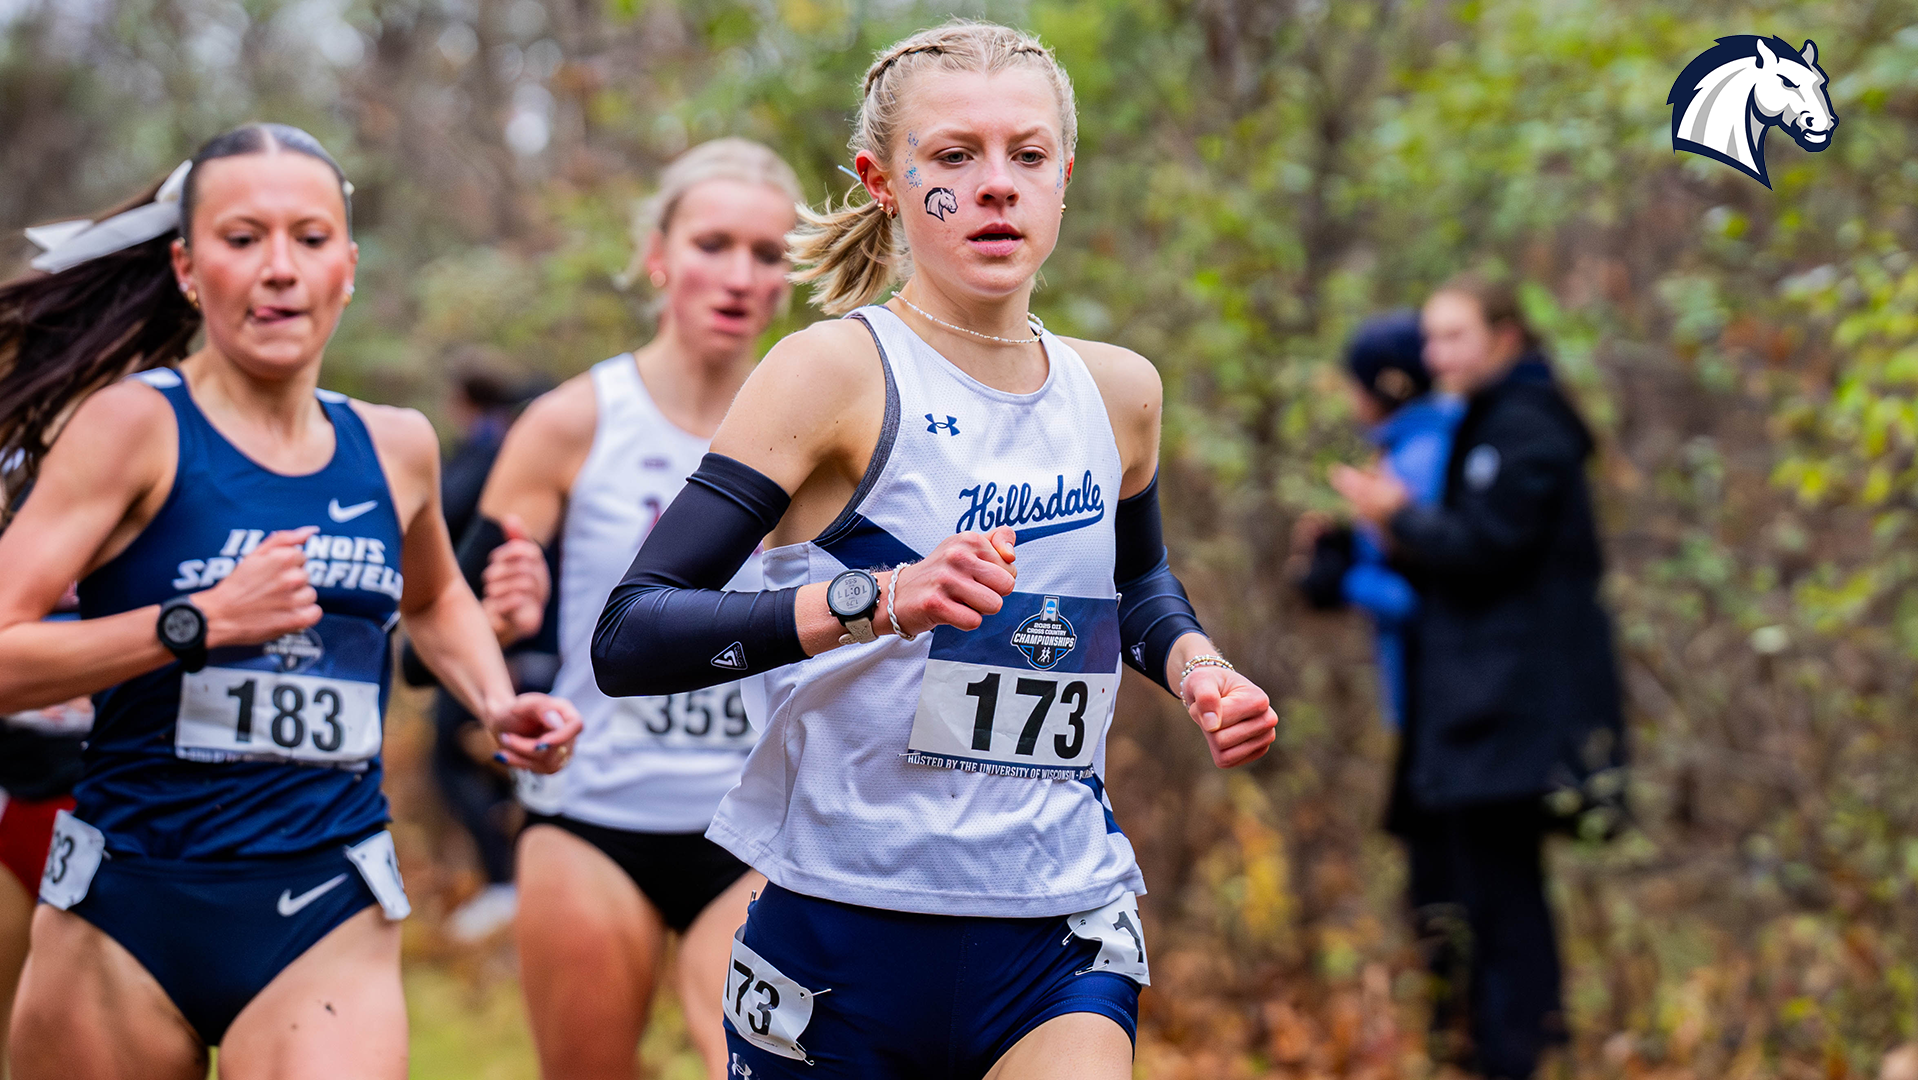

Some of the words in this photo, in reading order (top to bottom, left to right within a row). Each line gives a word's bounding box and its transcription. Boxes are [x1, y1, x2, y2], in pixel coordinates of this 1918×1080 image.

[956, 470, 1105, 534] Hillsdale
[219, 529, 386, 564] ILNOIS
[172, 556, 404, 600] SPGFIEL
[837, 585, 868, 599] 10:11
[1014, 633, 1074, 647] CHAMPIONSHIPS
[227, 679, 342, 752] 183
[645, 689, 749, 736] 359
[966, 672, 1089, 759] 173
[907, 754, 944, 768] HOSTED
[945, 759, 958, 770] BY
[960, 761, 978, 773] THE
[979, 763, 1029, 778] UNIVERSITY
[1030, 768, 1041, 779] OF
[1041, 769, 1076, 780] WISCONSIN
